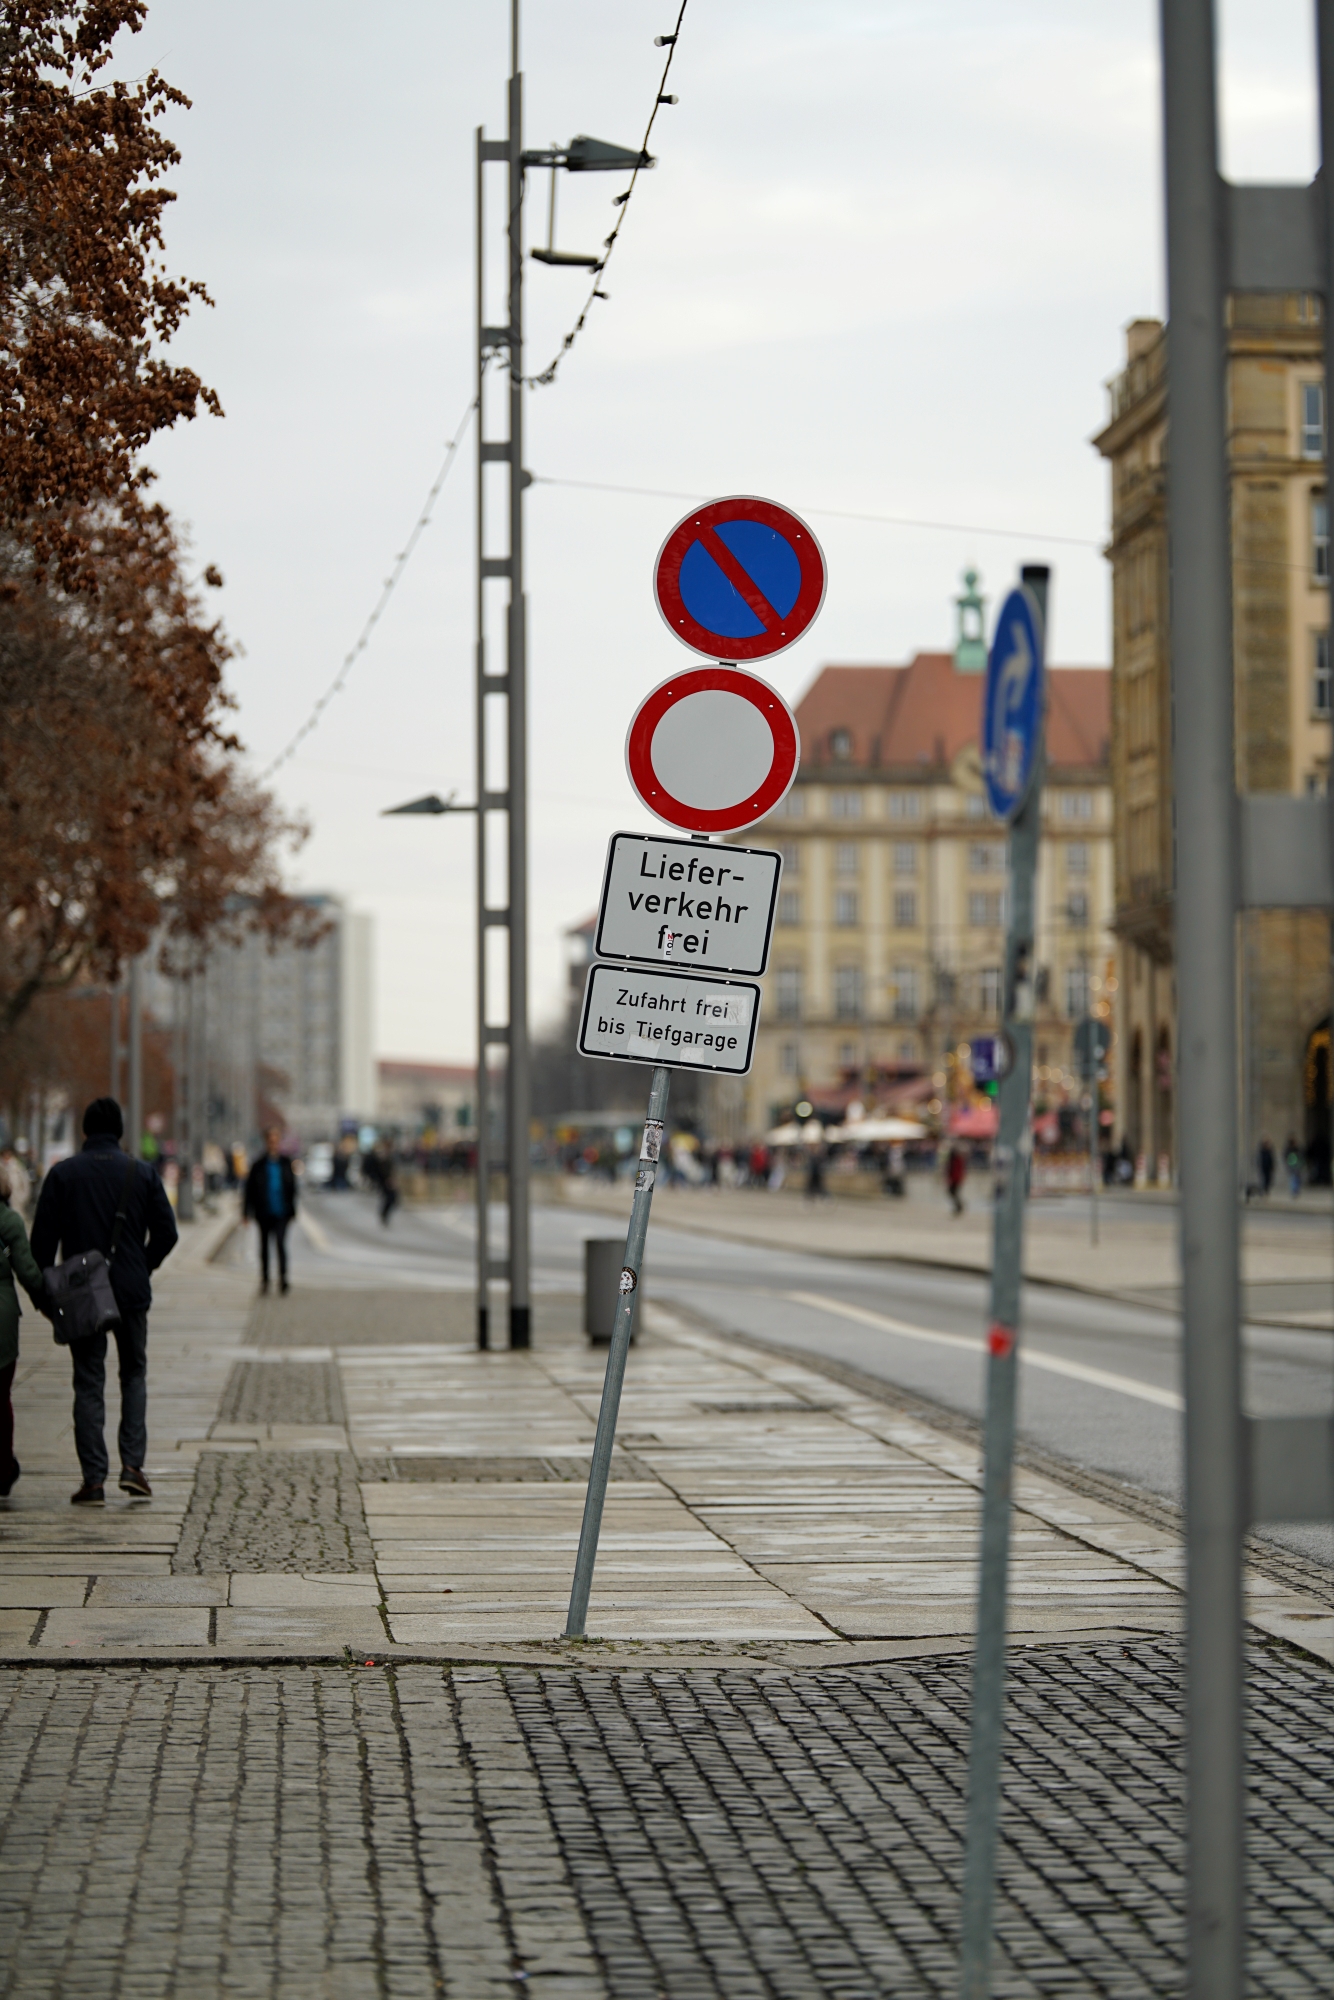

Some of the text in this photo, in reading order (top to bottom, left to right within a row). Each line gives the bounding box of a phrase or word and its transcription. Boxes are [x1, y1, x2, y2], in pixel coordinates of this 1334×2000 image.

[640, 851, 745, 886] Liefer-
[628, 891, 749, 924] verkehr
[616, 988, 729, 1019] Zufahrt frei
[597, 1016, 738, 1051] bis Tiefgarage
